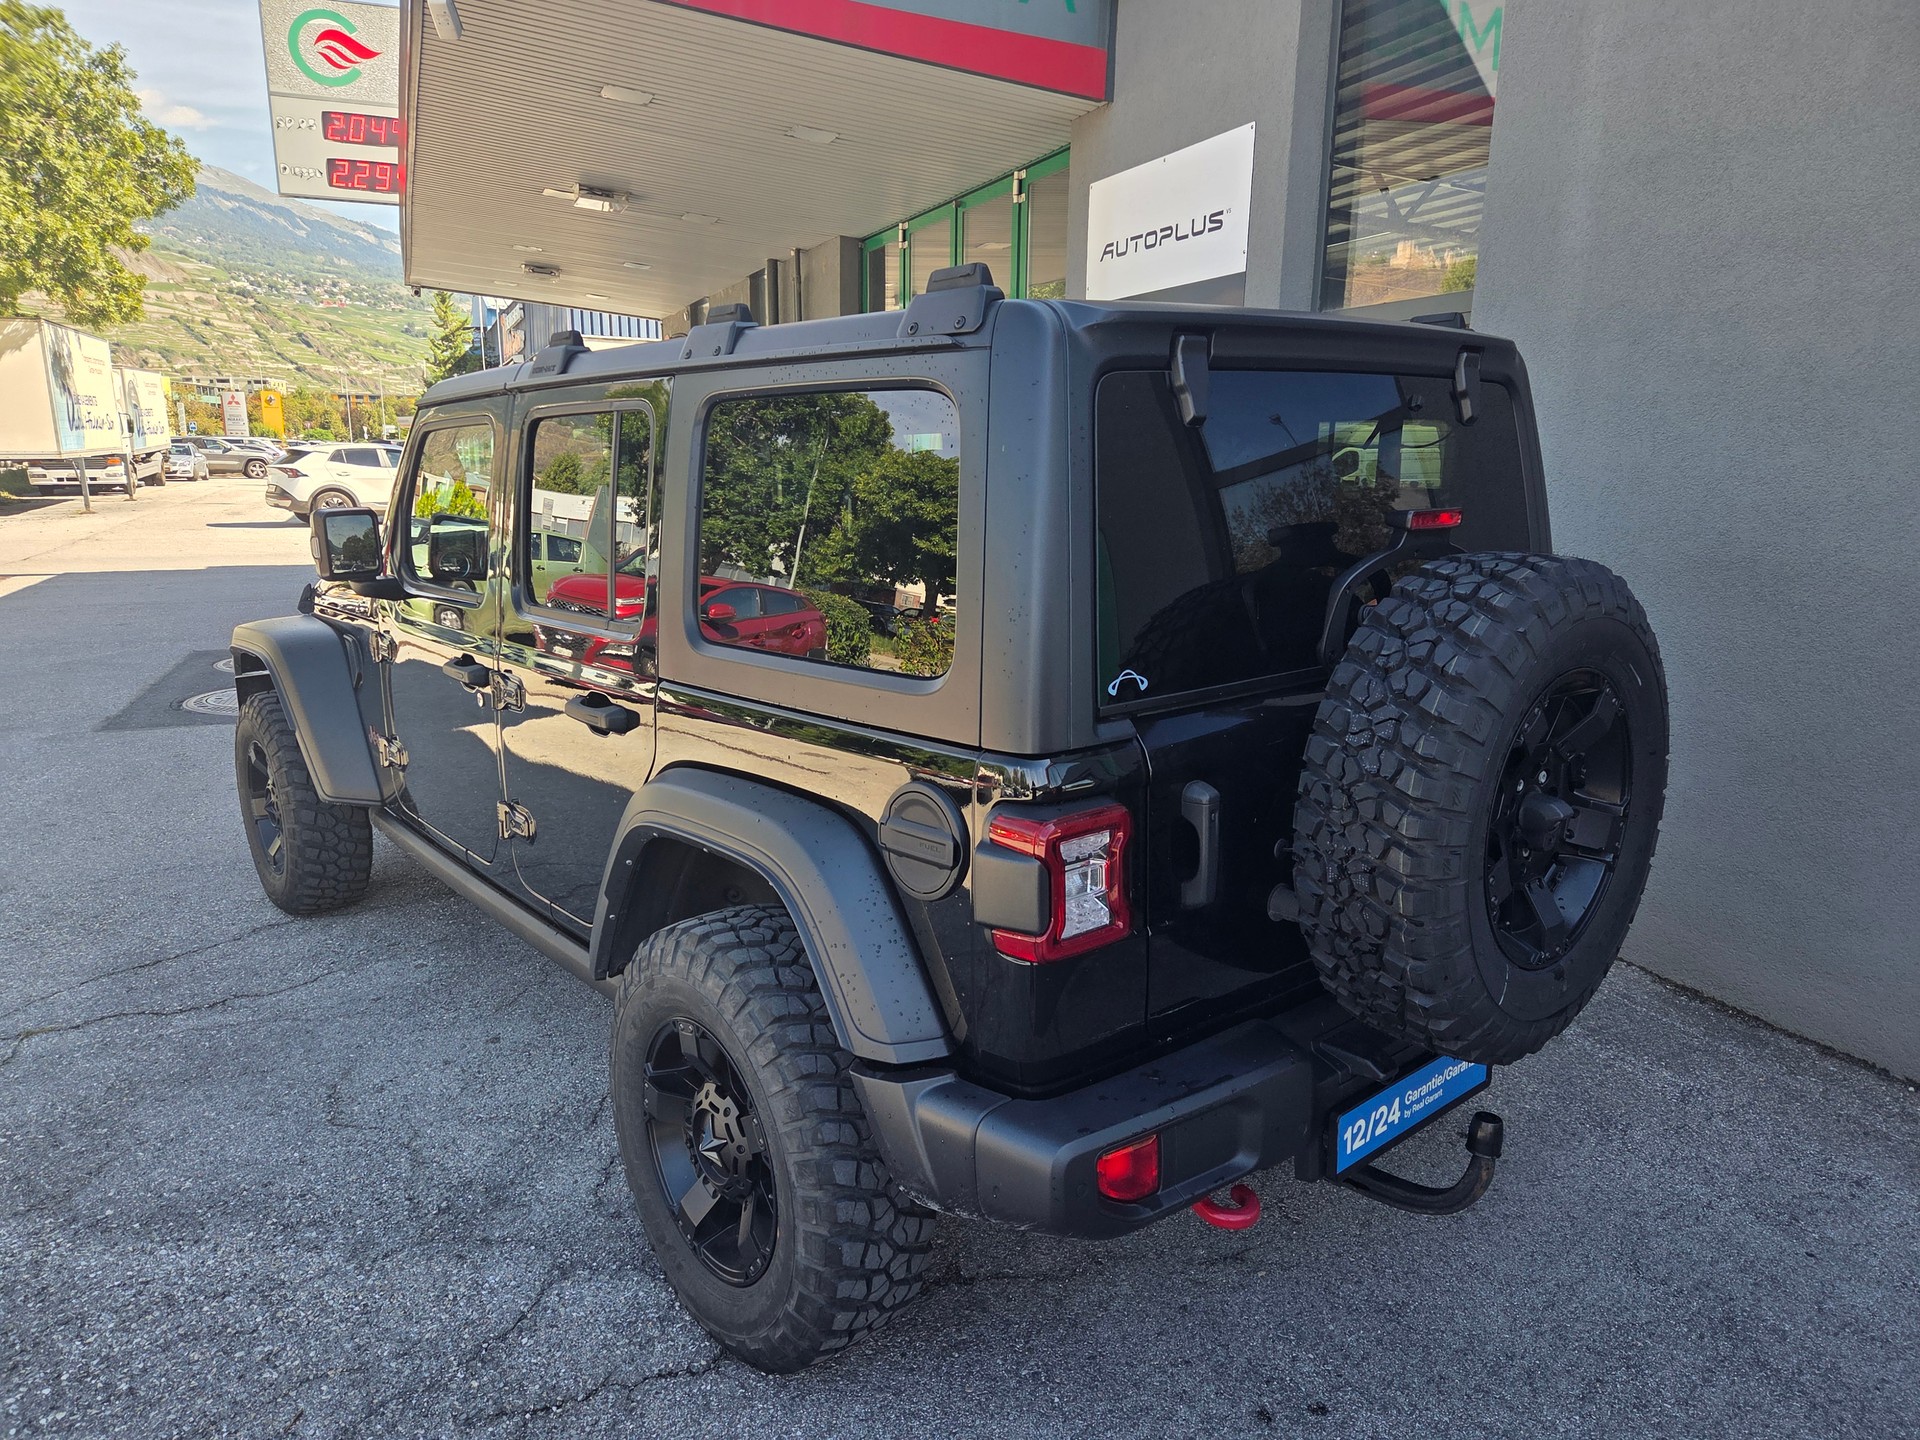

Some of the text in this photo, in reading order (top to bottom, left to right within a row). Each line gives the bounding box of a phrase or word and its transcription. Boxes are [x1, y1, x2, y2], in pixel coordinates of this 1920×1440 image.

[332, 160, 399, 191] 2.29
[1099, 209, 1224, 262] AUTOPLUS
[919, 841, 941, 853] FUEL
[1405, 1061, 1475, 1105] Garantie/Garan
[1404, 1089, 1443, 1118] by Real Garant
[1343, 1096, 1401, 1155] 12/24
